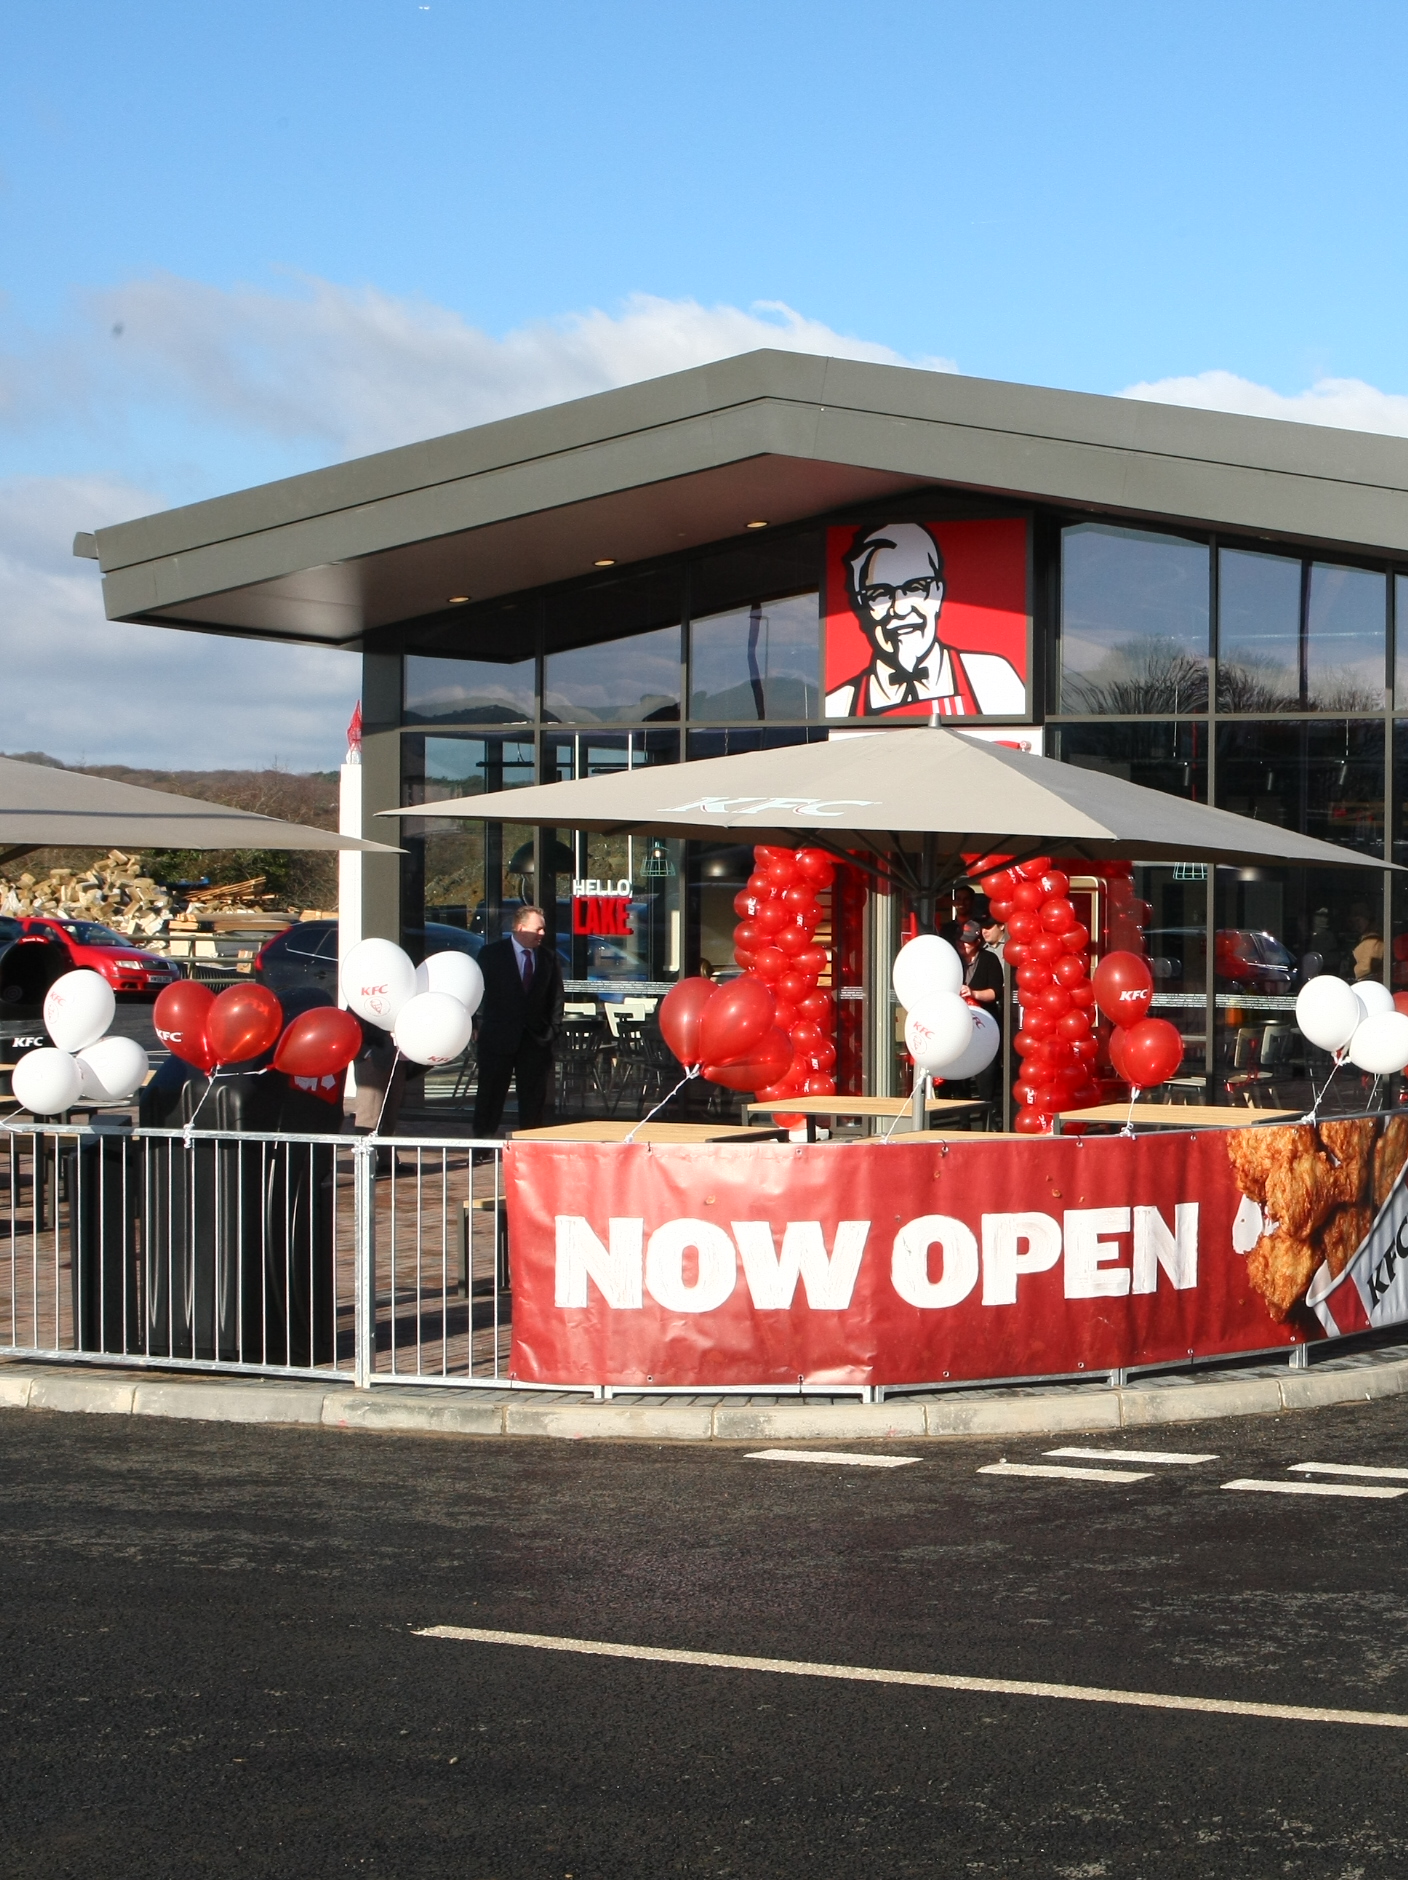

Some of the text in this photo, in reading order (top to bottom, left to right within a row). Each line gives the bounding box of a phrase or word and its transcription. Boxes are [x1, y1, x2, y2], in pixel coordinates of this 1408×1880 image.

[656, 796, 876, 818] KFC
[572, 879, 631, 897] HELLO
[573, 896, 634, 935] LAKE
[360, 982, 389, 996] KFC
[1119, 988, 1149, 1001] KFC
[50, 991, 65, 1006] KFC
[155, 1027, 182, 1042] KFC
[913, 1021, 935, 1040] KFC
[12, 1036, 44, 1047] KFC
[554, 1202, 1200, 1314] NOW OPEN
